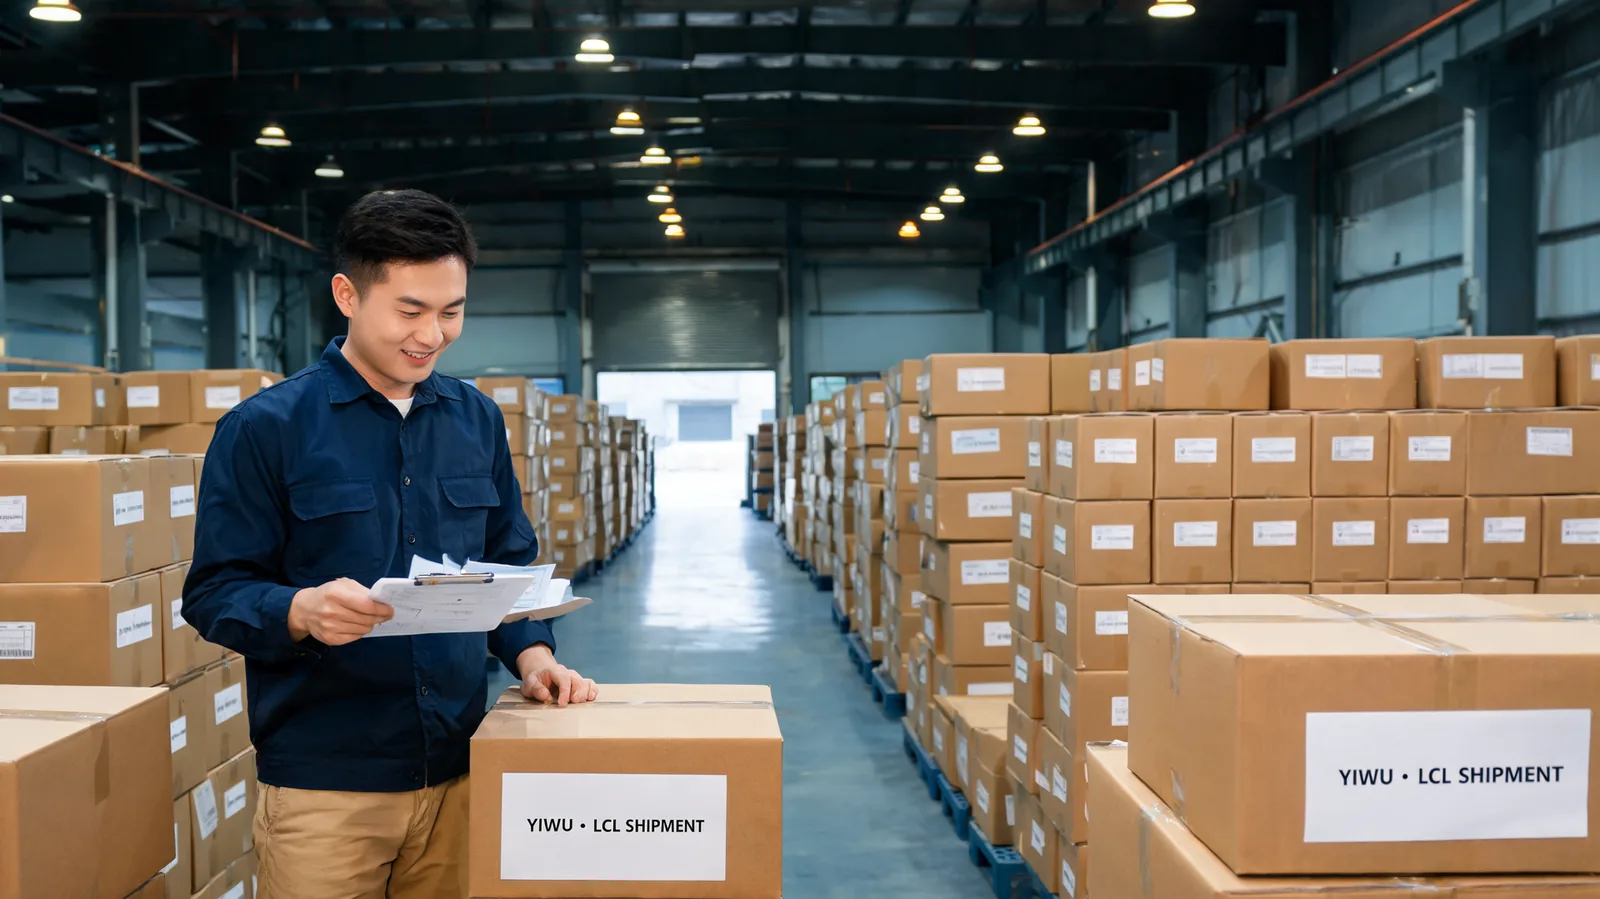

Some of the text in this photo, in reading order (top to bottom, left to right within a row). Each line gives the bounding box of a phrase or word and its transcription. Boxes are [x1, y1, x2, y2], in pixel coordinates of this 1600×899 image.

[1339, 765, 1564, 785] YIWU LCL SHIPMENT
[527, 818, 704, 832] YIWU LCL SHIPMENT
